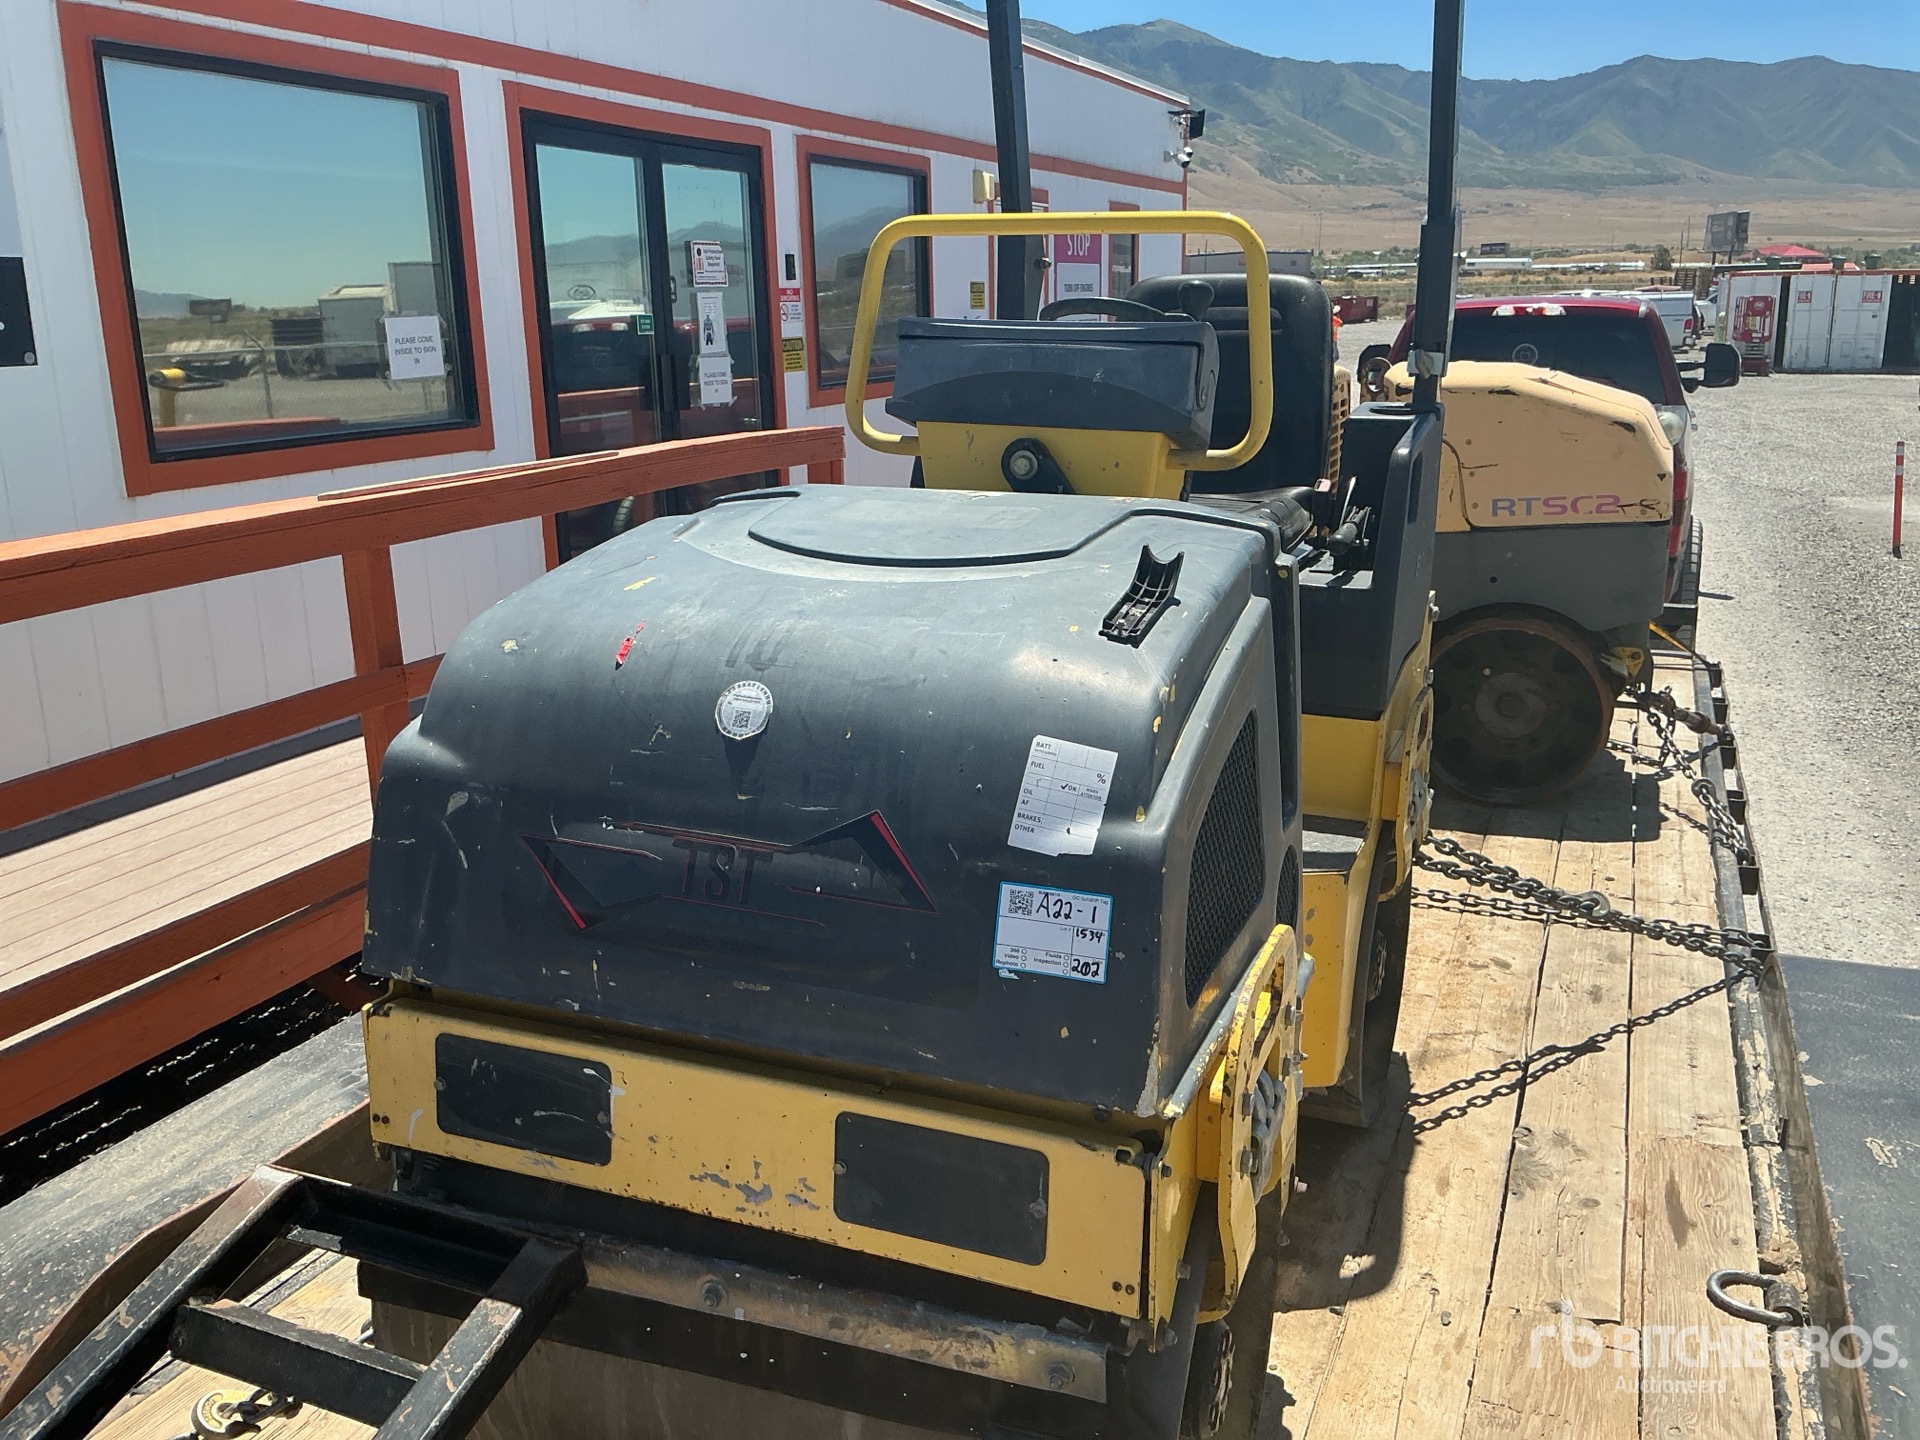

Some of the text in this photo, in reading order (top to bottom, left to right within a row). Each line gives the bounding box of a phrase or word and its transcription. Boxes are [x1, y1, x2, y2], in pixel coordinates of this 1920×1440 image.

[1067, 234, 1091, 256] STOP
[394, 335, 434, 345] PLEASE COME
[394, 347, 414, 355] INSIDE
[1035, 741, 1052, 750] BATT
[1030, 760, 1046, 770] FUEL
[1096, 772, 1107, 785] %
[1023, 788, 1034, 796] OIL
[1017, 812, 1042, 824] BRAKES
[1014, 823, 1036, 834] OTHER
[1075, 928, 1103, 943] 1534
[1033, 957, 1062, 966] Inspection
